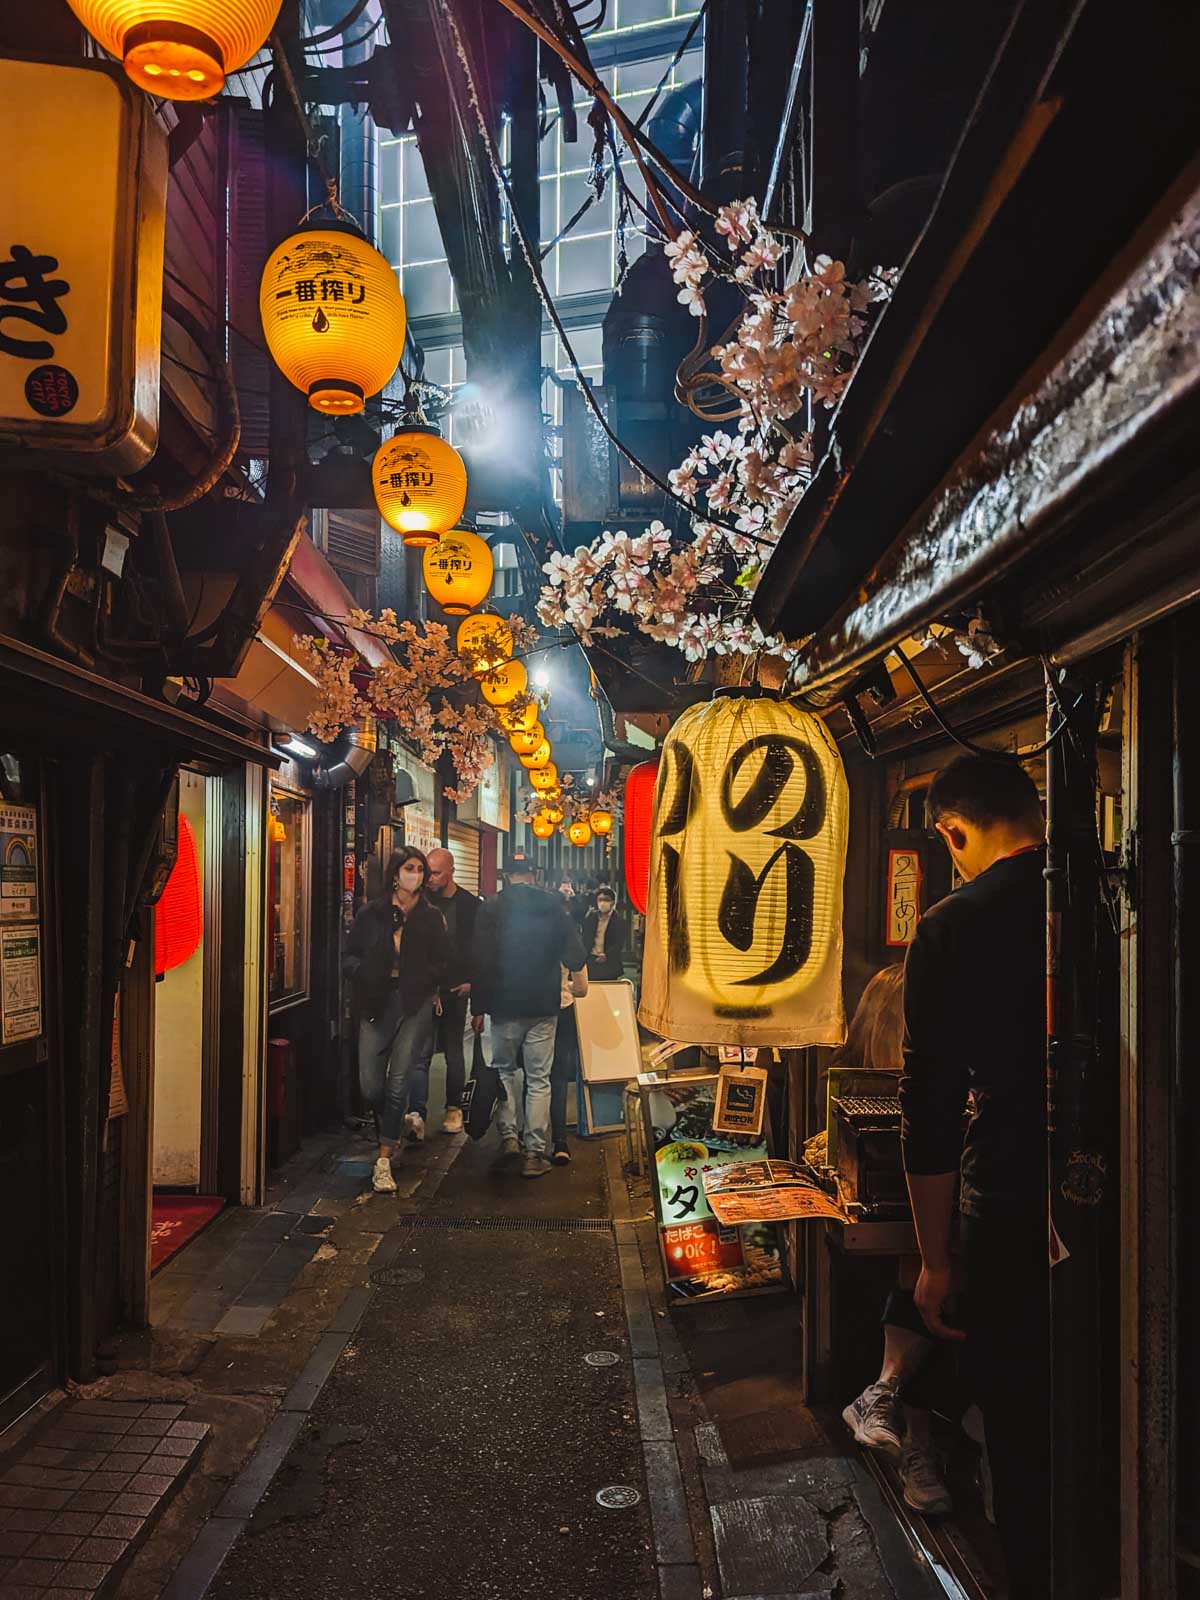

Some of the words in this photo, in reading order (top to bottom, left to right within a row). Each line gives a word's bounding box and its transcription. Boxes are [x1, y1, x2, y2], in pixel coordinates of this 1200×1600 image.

[276, 279, 365, 304] 一番搾り
[380, 471, 434, 489] 一番搾り
[430, 558, 472, 571] 一番搾り
[664, 1224, 707, 1244] たばこ
